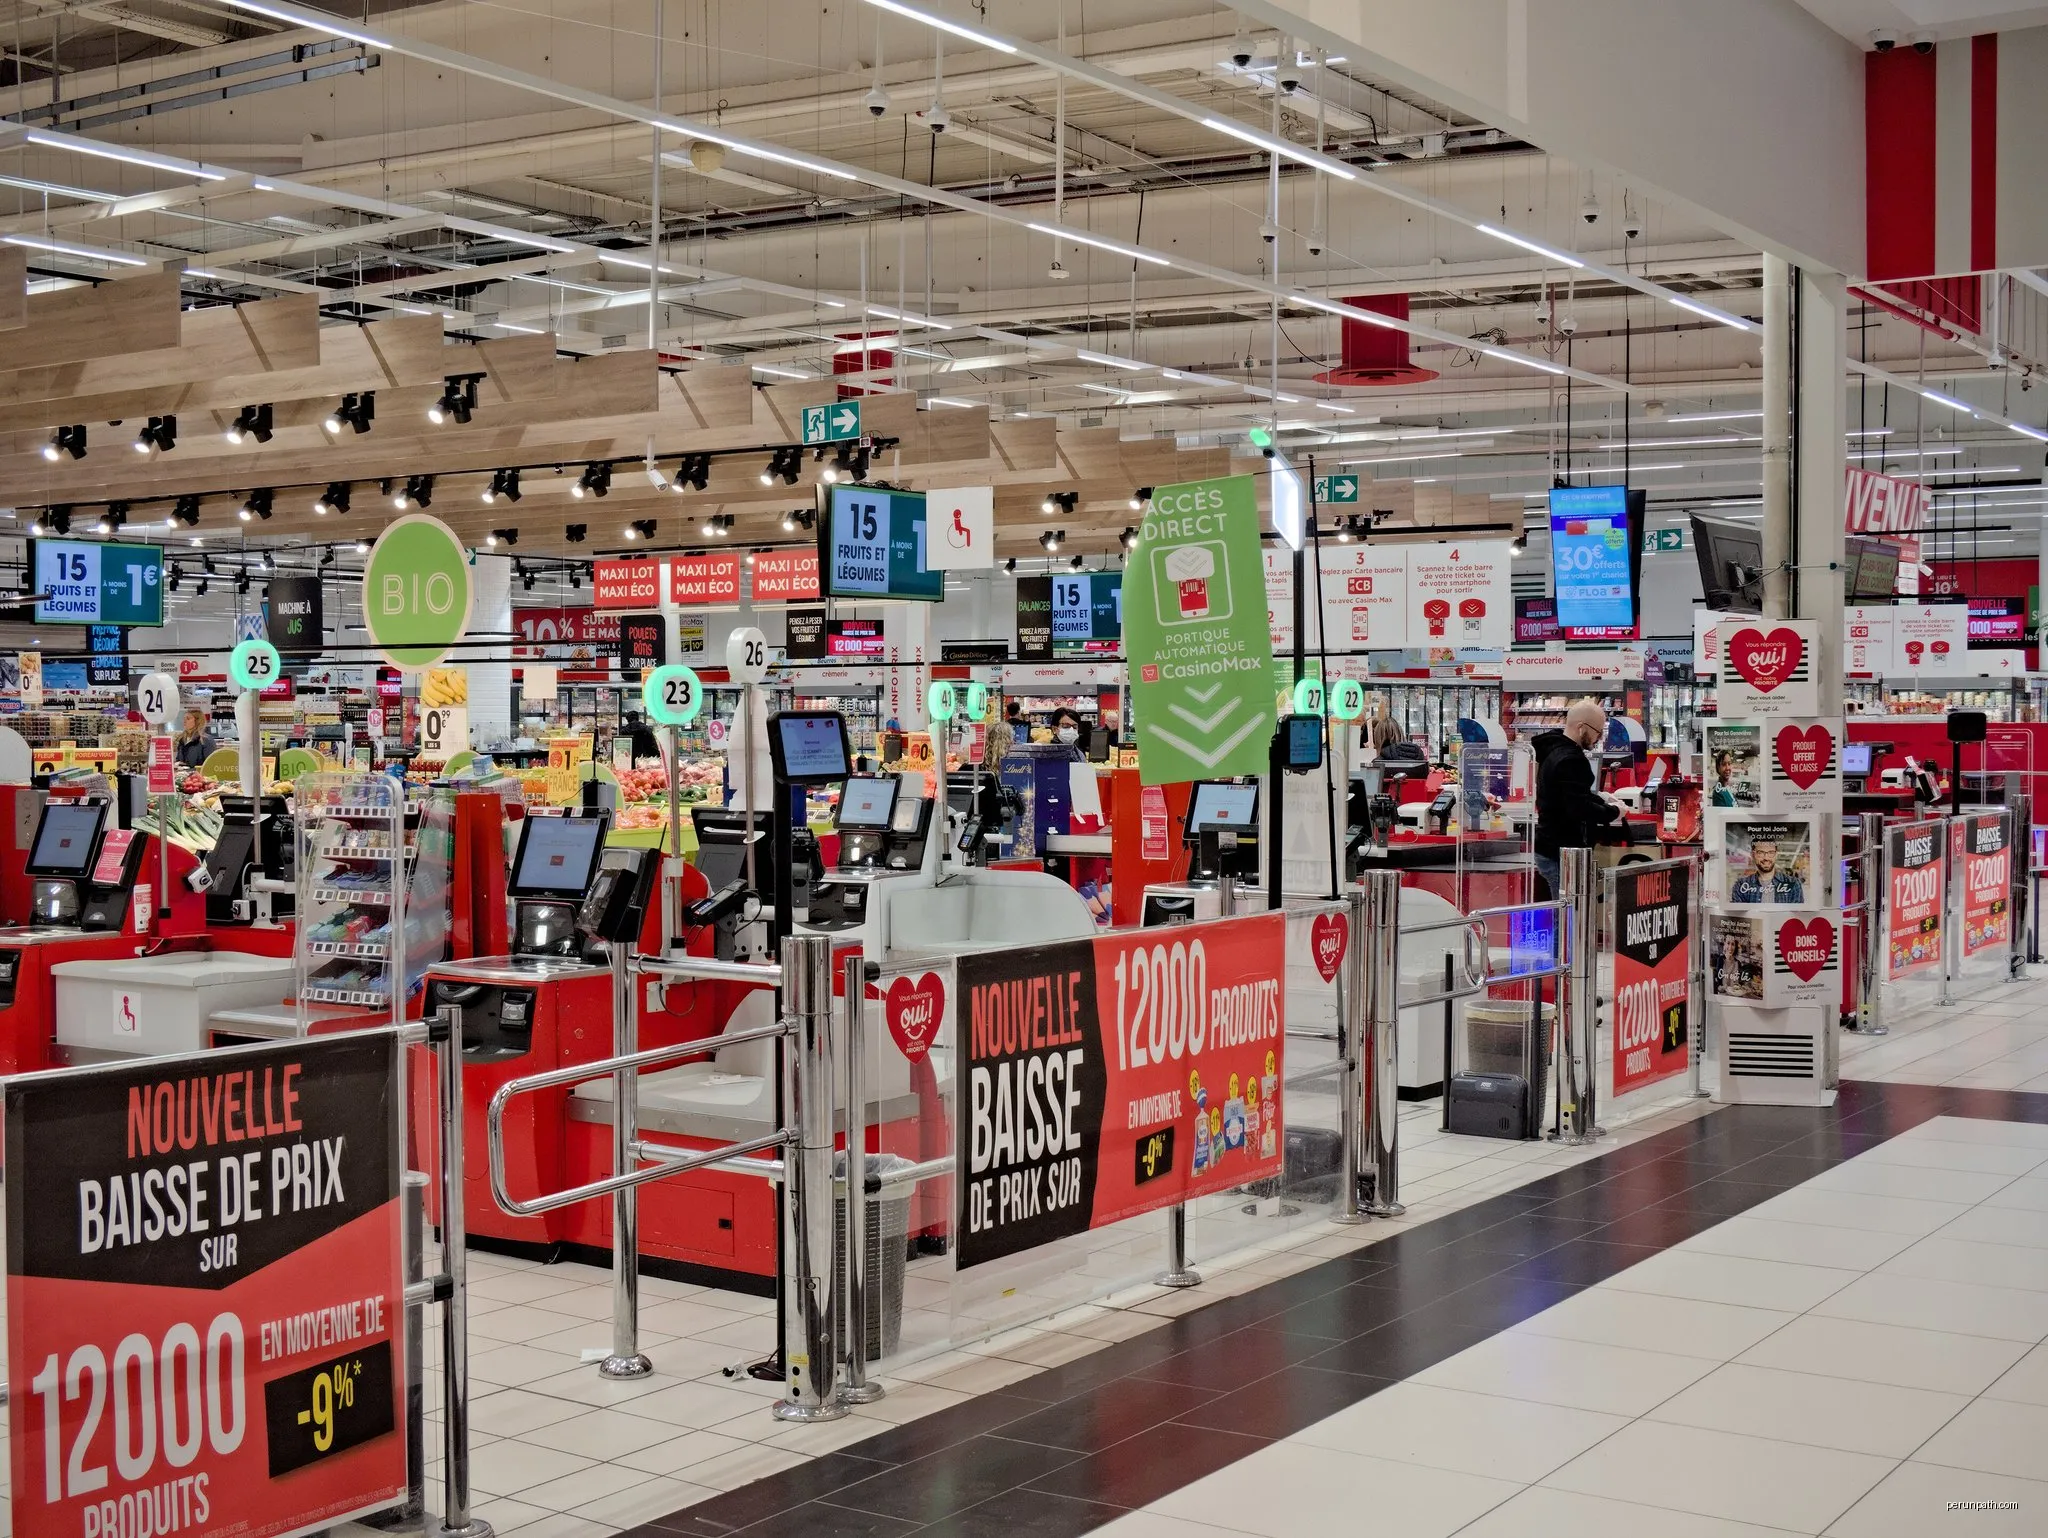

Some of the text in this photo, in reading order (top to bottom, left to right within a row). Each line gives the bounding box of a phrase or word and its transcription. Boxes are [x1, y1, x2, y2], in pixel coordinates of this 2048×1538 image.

[1144, 486, 1224, 517] ACCÈS
[850, 503, 877, 541] 15
[1143, 513, 1228, 541] DIRECT
[838, 544, 886, 561] FRUITS ET
[896, 541, 913, 550] MOINS
[1267, 555, 1273, 567] 1
[1356, 552, 1365, 565] 3
[1449, 549, 1460, 562] 4
[57, 553, 87, 581] 15
[600, 566, 654, 581] MAXI LOT
[676, 562, 734, 577] MAXI LOT
[758, 558, 819, 573] MAXI LOT
[837, 562, 885, 582] LÉGUMES
[1593, 561, 1626, 569] offerts
[600, 581, 655, 598] MAXI ÉCO
[676, 578, 734, 595] MAXI ÉCO
[758, 573, 819, 592] MAXI ÉCO
[1355, 580, 1371, 591] CB
[1449, 579, 1492, 588] smartphone
[84, 586, 96, 597] ET
[382, 573, 454, 616] BIO
[1056, 584, 1081, 607] 15
[278, 600, 312, 615] MACHINE À
[1018, 601, 1050, 612] BALANCES
[1079, 609, 1088, 618] ET
[1856, 609, 1863, 618] 3
[1924, 608, 1931, 617] 4
[287, 617, 303, 635] JUS
[789, 616, 822, 625] PENSEZ PESER
[842, 621, 876, 630] NOUVELLE
[628, 626, 657, 640] POULETS
[791, 626, 800, 634] VOS
[1019, 627, 1050, 636] PENSEZ PESER
[1165, 627, 1230, 646] PORTIQUE
[1855, 628, 1868, 636] CB
[746, 641, 763, 666] 26
[1154, 641, 1245, 661] AUTOMATIQUE
[248, 656, 270, 674] 25
[629, 658, 657, 668] SUR PLACE
[1162, 656, 1262, 679] CasinoMax
[1516, 656, 1563, 665] charcuterie
[94, 669, 121, 681] SUR PLACE
[821, 670, 848, 678] crèmerie
[1034, 668, 1064, 676] crèmerie
[1578, 666, 1609, 675] traiteur
[665, 680, 690, 705] 23
[891, 677, 899, 706] INFO
[1308, 689, 1321, 709] 27
[1345, 690, 1358, 708] 22
[144, 689, 164, 713] 24
[1792, 741, 1816, 751] PRODUIT
[1793, 752, 1816, 761] OFFERT
[281, 761, 306, 777] BIO
[1004, 763, 1026, 774] Lindt
[1790, 763, 1818, 772] EN CAISSE
[1976, 826, 2002, 845] BAISSE
[1904, 836, 1933, 858] BAISSE
[1968, 854, 2005, 891] 12000
[1636, 869, 1671, 907] NOUVELLE
[1740, 882, 1774, 893] On est
[1894, 867, 1937, 909] 12000
[1975, 887, 2000, 904] PRODUITS
[1902, 902, 1931, 922] PRODUITS
[1626, 904, 1679, 946] BAISSE DE PRIX
[1795, 935, 1818, 948] BONS
[1648, 943, 1658, 960] SUR
[1787, 949, 1826, 963] CONSEILS
[1114, 938, 1207, 1072] 12000
[971, 971, 1083, 1061] NOUVELLE
[1210, 977, 1279, 1051] PRODUITS
[1617, 977, 1660, 1051] 12000
[1625, 1046, 1651, 1077] PRODUITS
[127, 1062, 303, 1160] NOUVELLE
[970, 1049, 1084, 1174] BAISSE
[1128, 1089, 1183, 1130] EN MOYENNE DE
[79, 1135, 346, 1255] BAISSE DE PRIX
[970, 1181, 994, 1234] DE
[999, 1169, 1042, 1226] PRIX
[1046, 1157, 1082, 1213] SUR
[200, 1232, 238, 1274] SUR
[260, 1294, 385, 1363] EN MOYENNE DE
[32, 1310, 247, 1505] 12000
[83, 1472, 210, 1538] PRODUITS
